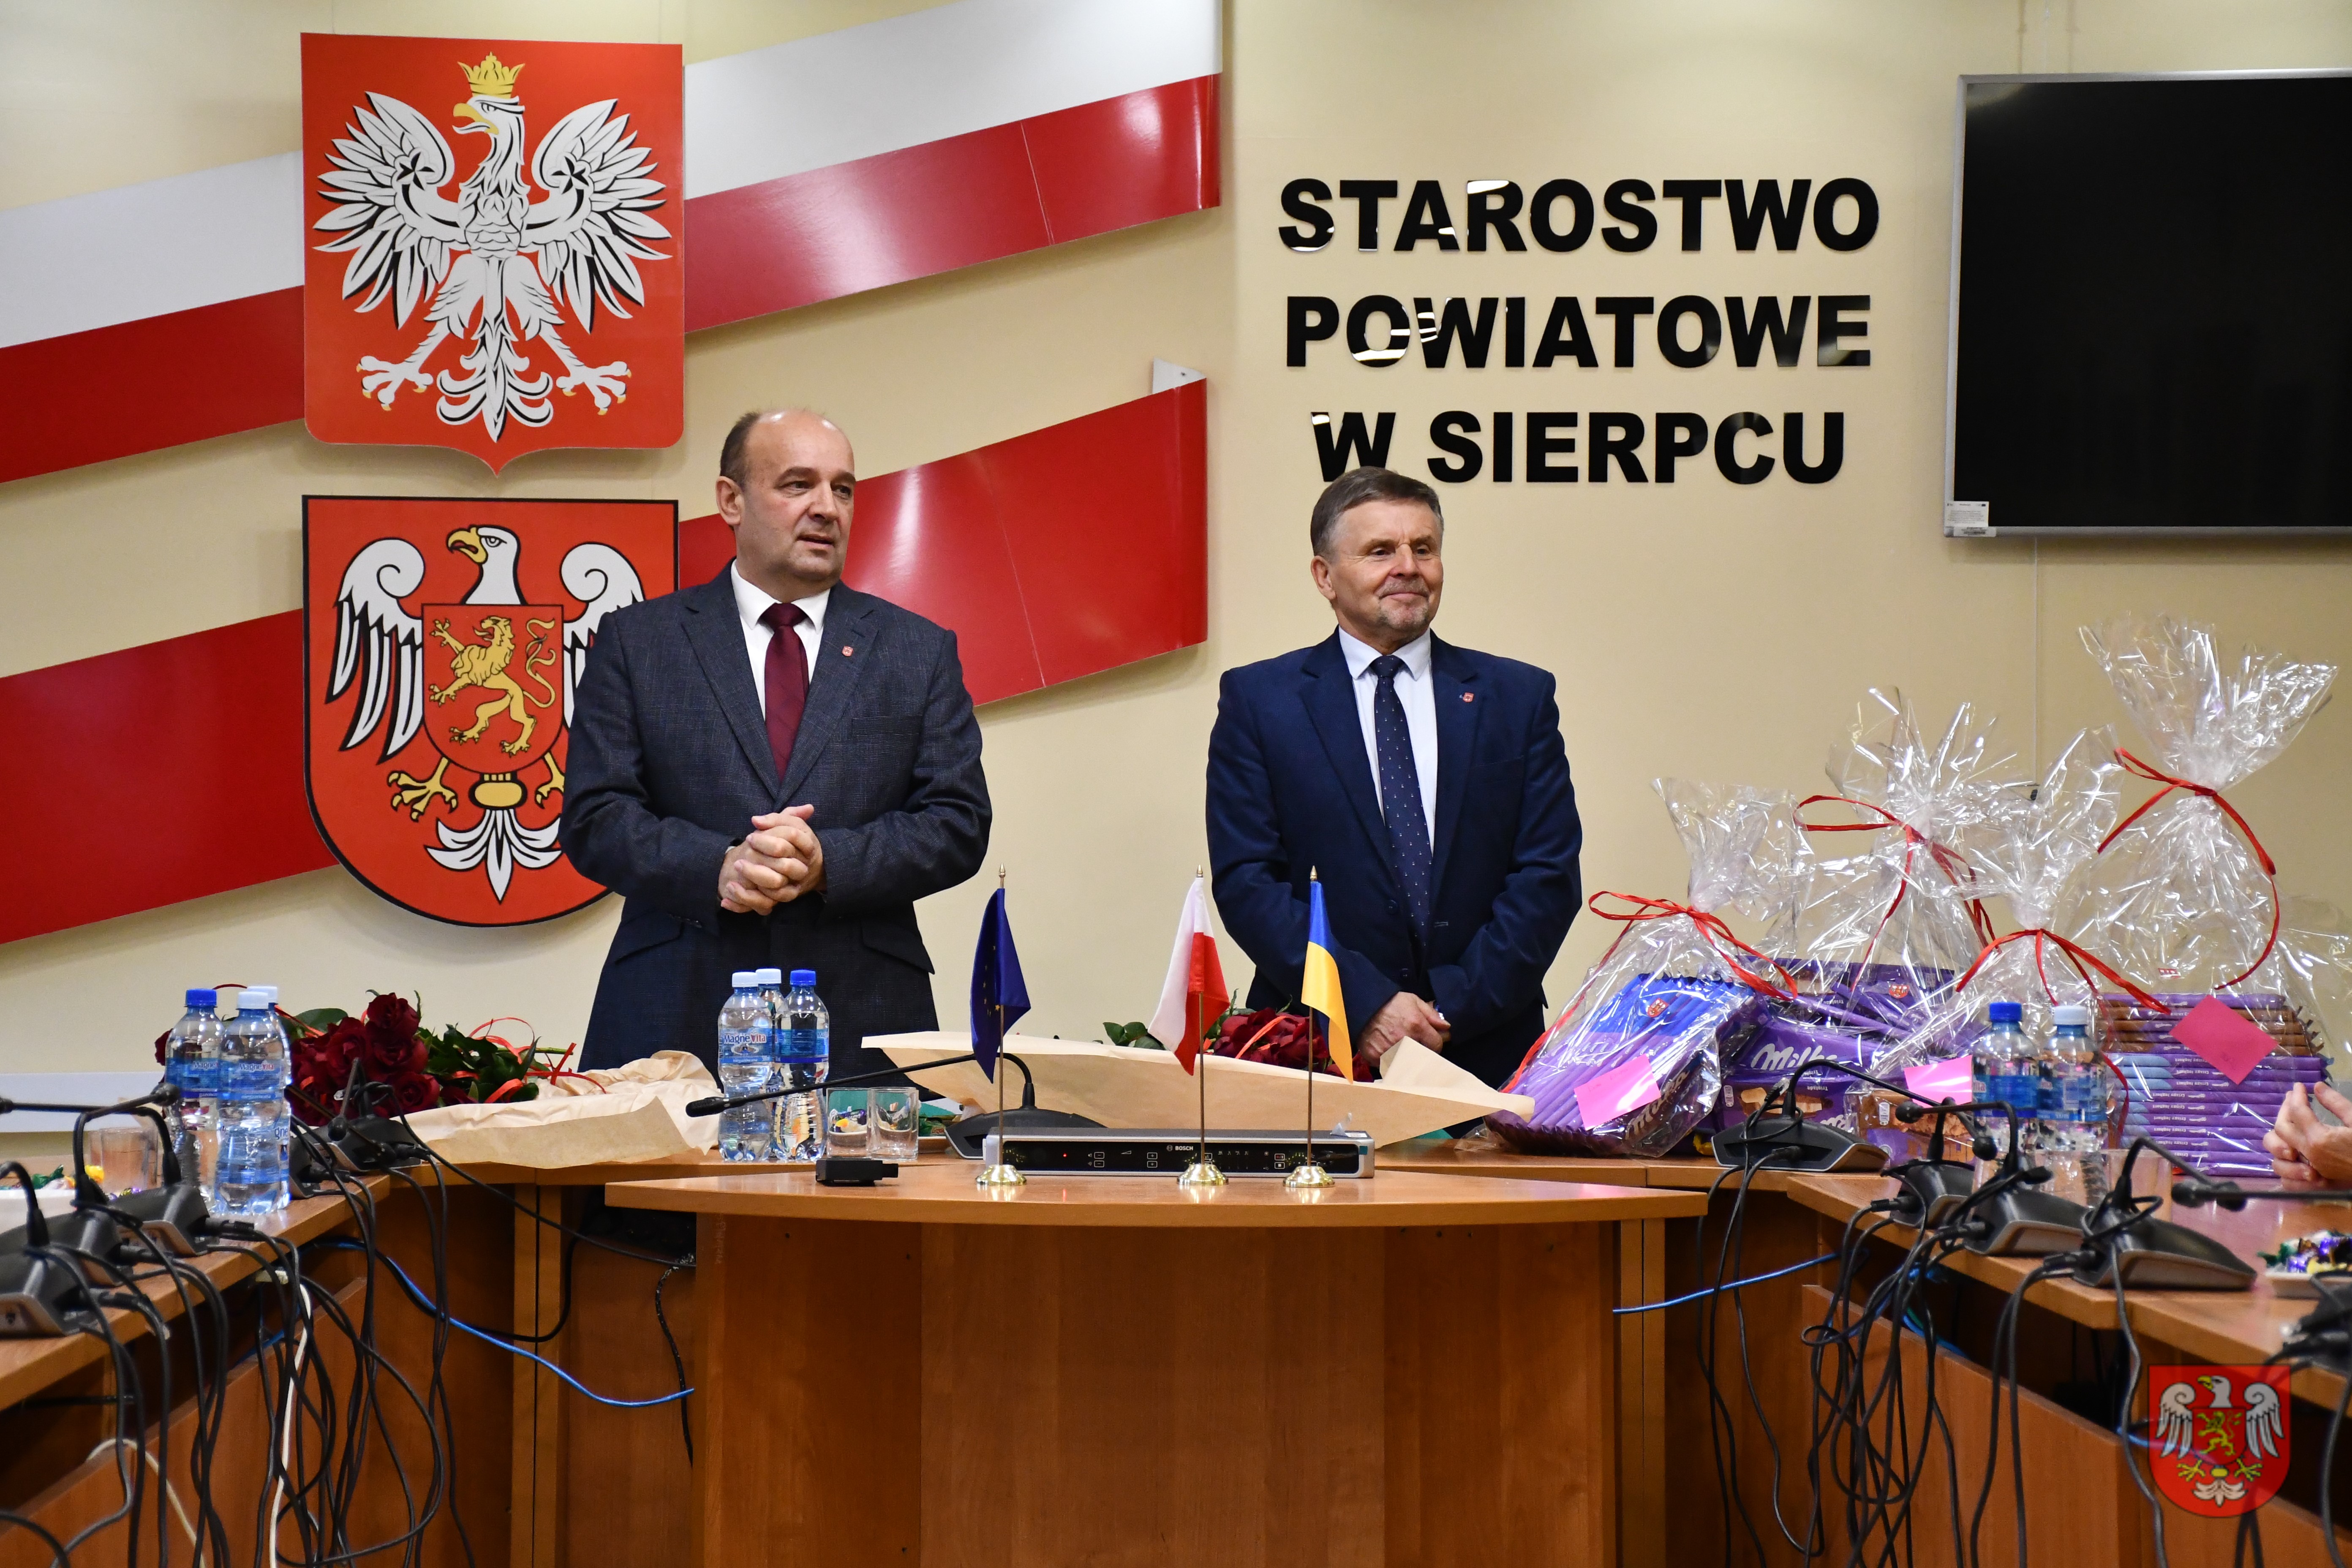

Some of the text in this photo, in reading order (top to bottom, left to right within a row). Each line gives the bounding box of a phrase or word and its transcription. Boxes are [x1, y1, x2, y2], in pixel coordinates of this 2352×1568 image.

[1278, 178, 1879, 252] STAROSTWO
[1286, 294, 1871, 368] POWIATOWE
[1310, 410, 1844, 484] W SIERPCU
